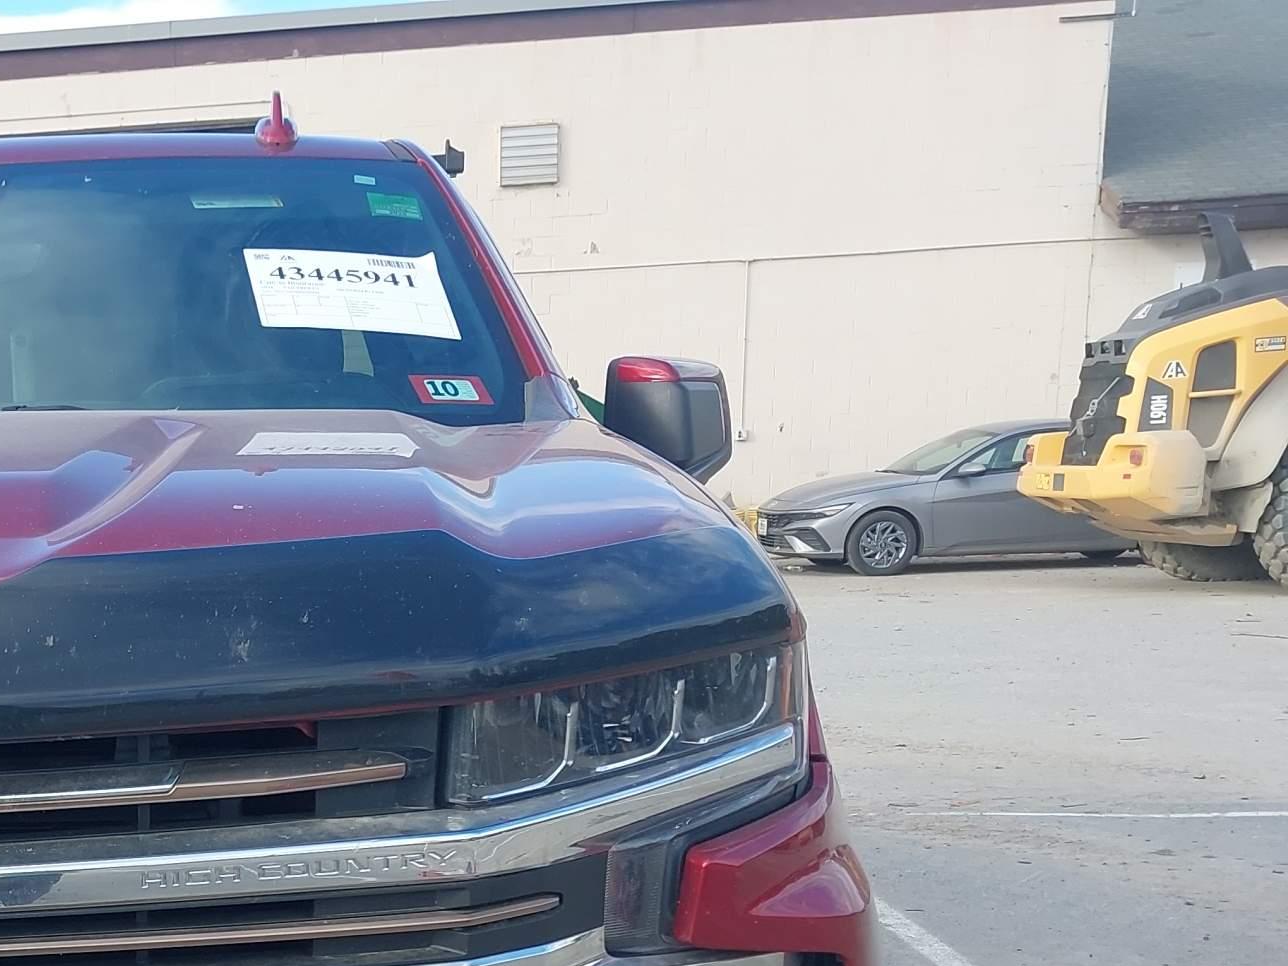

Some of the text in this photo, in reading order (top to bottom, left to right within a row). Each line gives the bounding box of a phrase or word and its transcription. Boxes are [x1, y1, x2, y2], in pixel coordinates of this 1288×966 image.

[269, 265, 418, 289] 43445941
[426, 380, 460, 397] 10
[1149, 394, 1168, 425] L90H
[140, 849, 458, 889] HIGH COUNTRY
